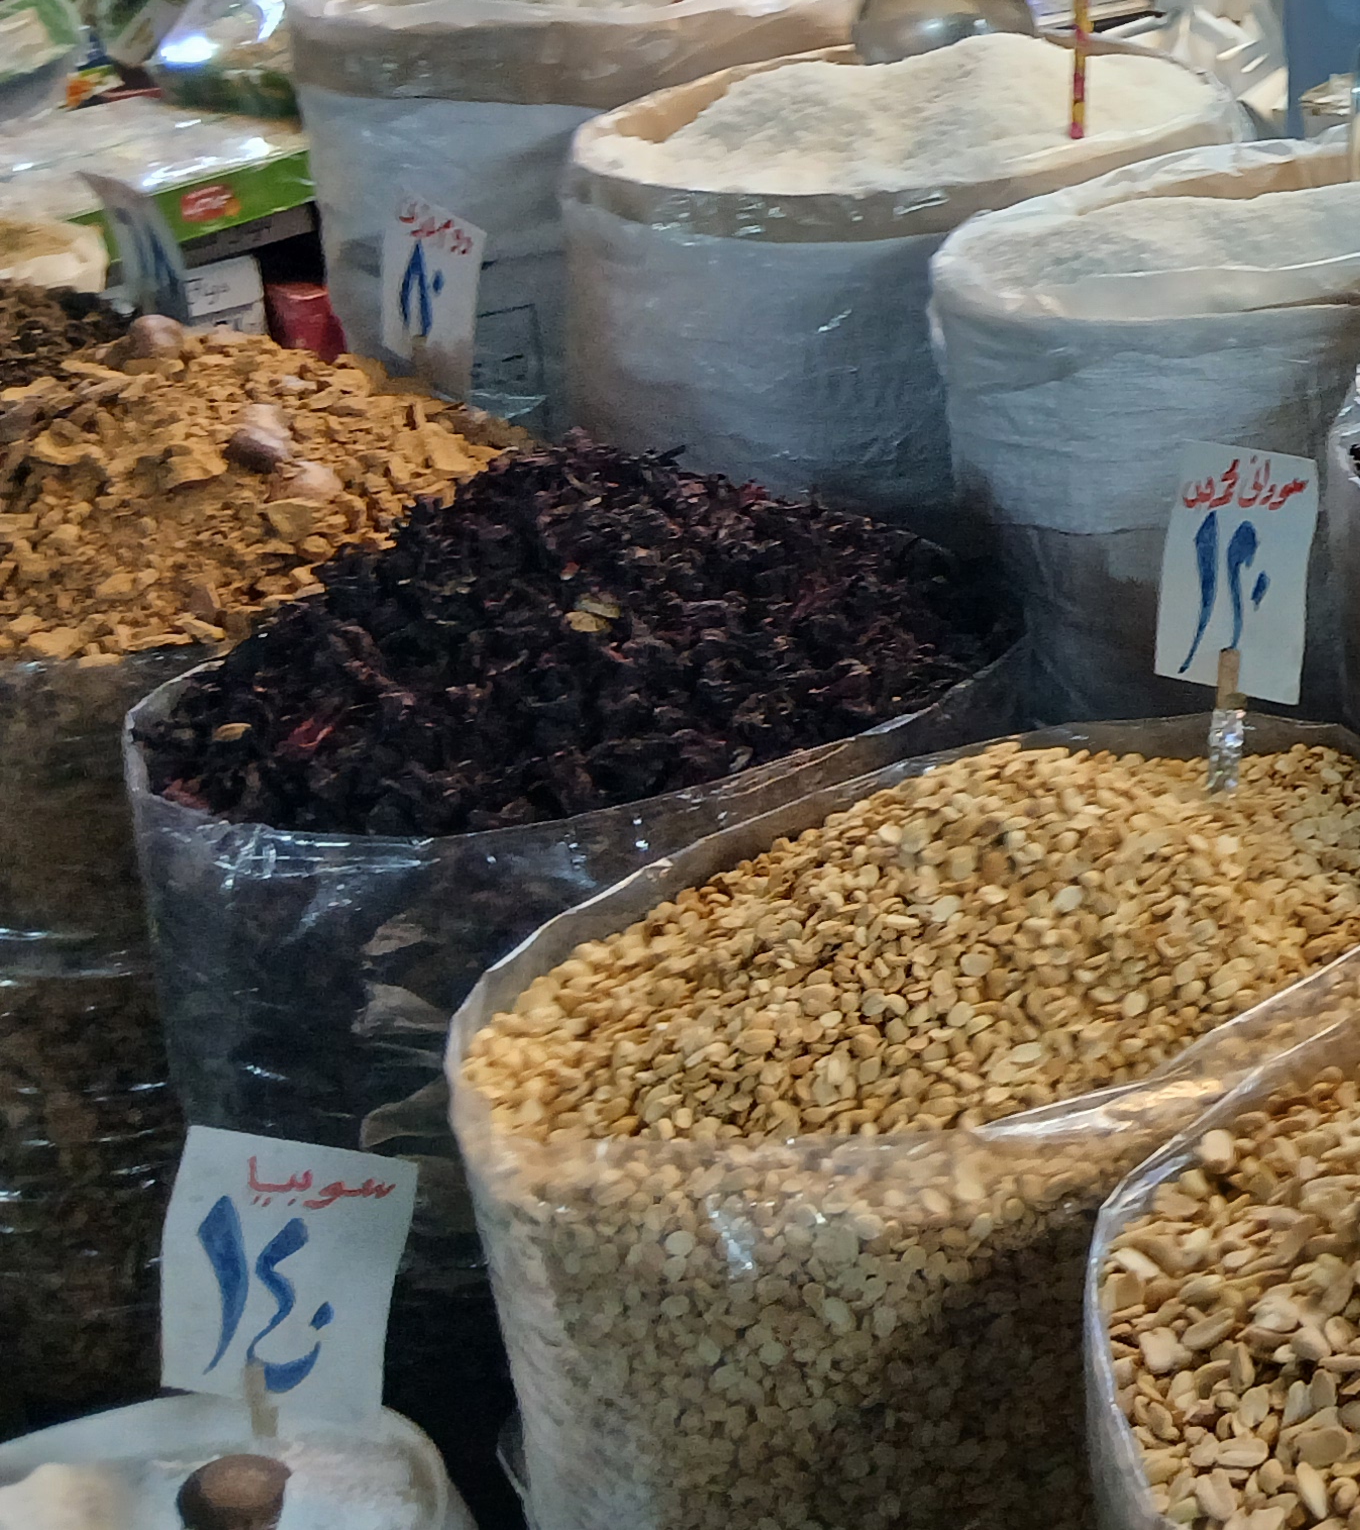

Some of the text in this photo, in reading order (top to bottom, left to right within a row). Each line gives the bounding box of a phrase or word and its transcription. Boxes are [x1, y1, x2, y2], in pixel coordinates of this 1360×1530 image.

[1177, 510, 1271, 675] ١٢٠
[247, 1154, 397, 1210] سوبيا
[196, 1194, 336, 1394] ١٤٠
